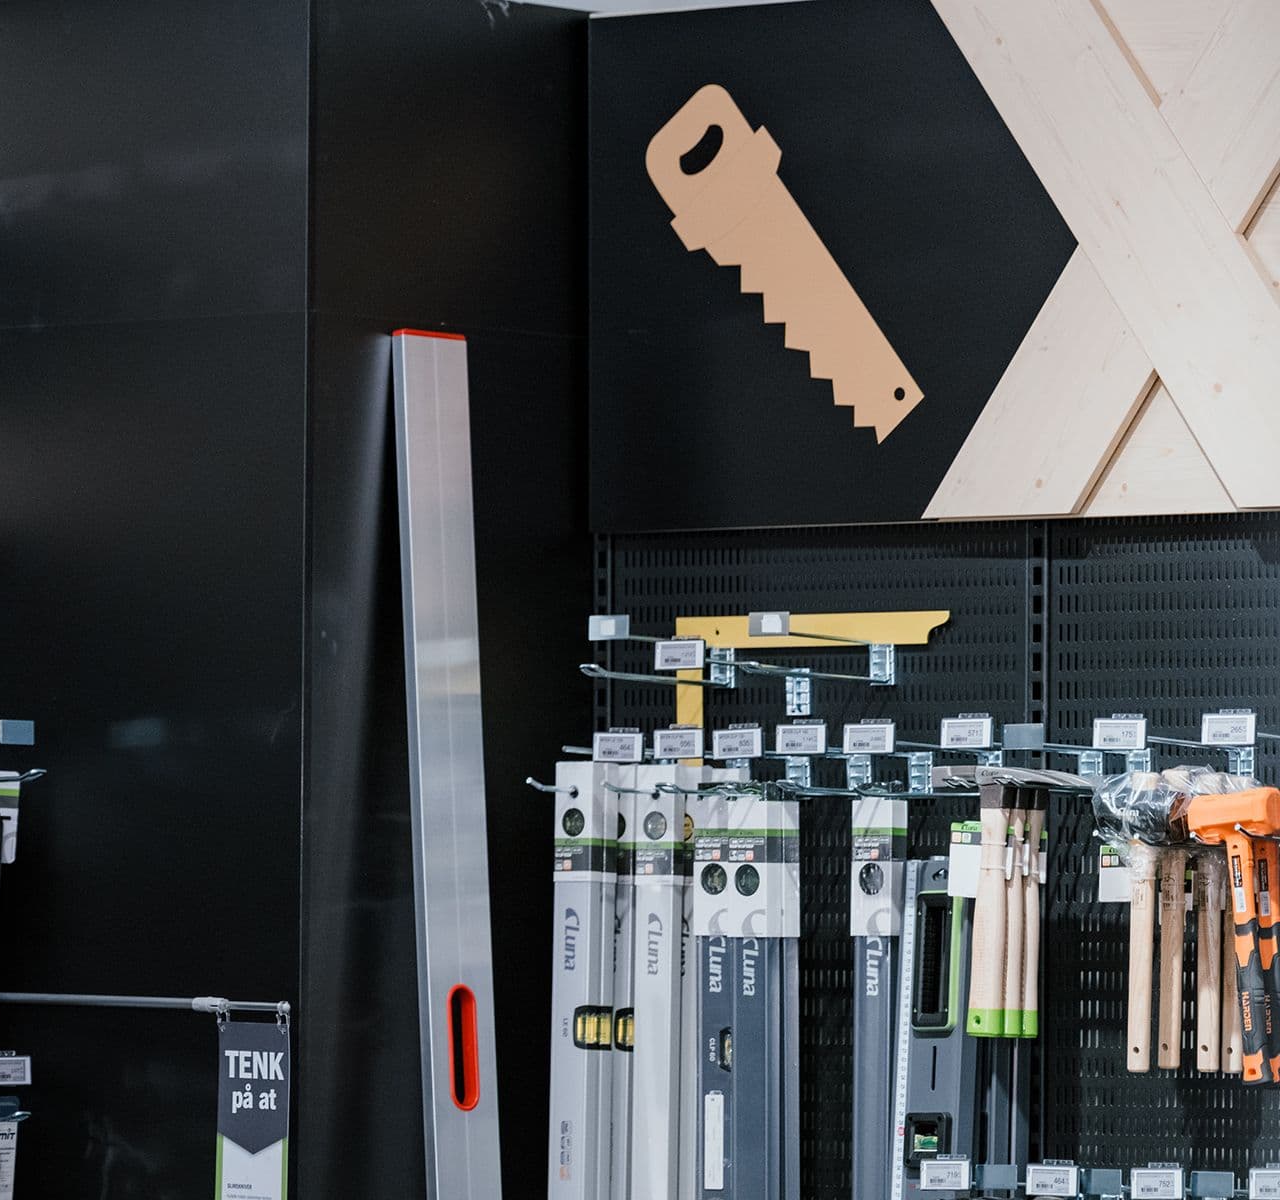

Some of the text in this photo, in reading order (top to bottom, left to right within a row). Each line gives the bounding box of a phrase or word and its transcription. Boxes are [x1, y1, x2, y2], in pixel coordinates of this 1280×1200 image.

[564, 906, 581, 972] Luna
[648, 912, 663, 976] Luna
[1241, 991, 1253, 1033] HARDEN
[225, 1050, 284, 1080] TENK
[232, 1083, 276, 1113] på at
